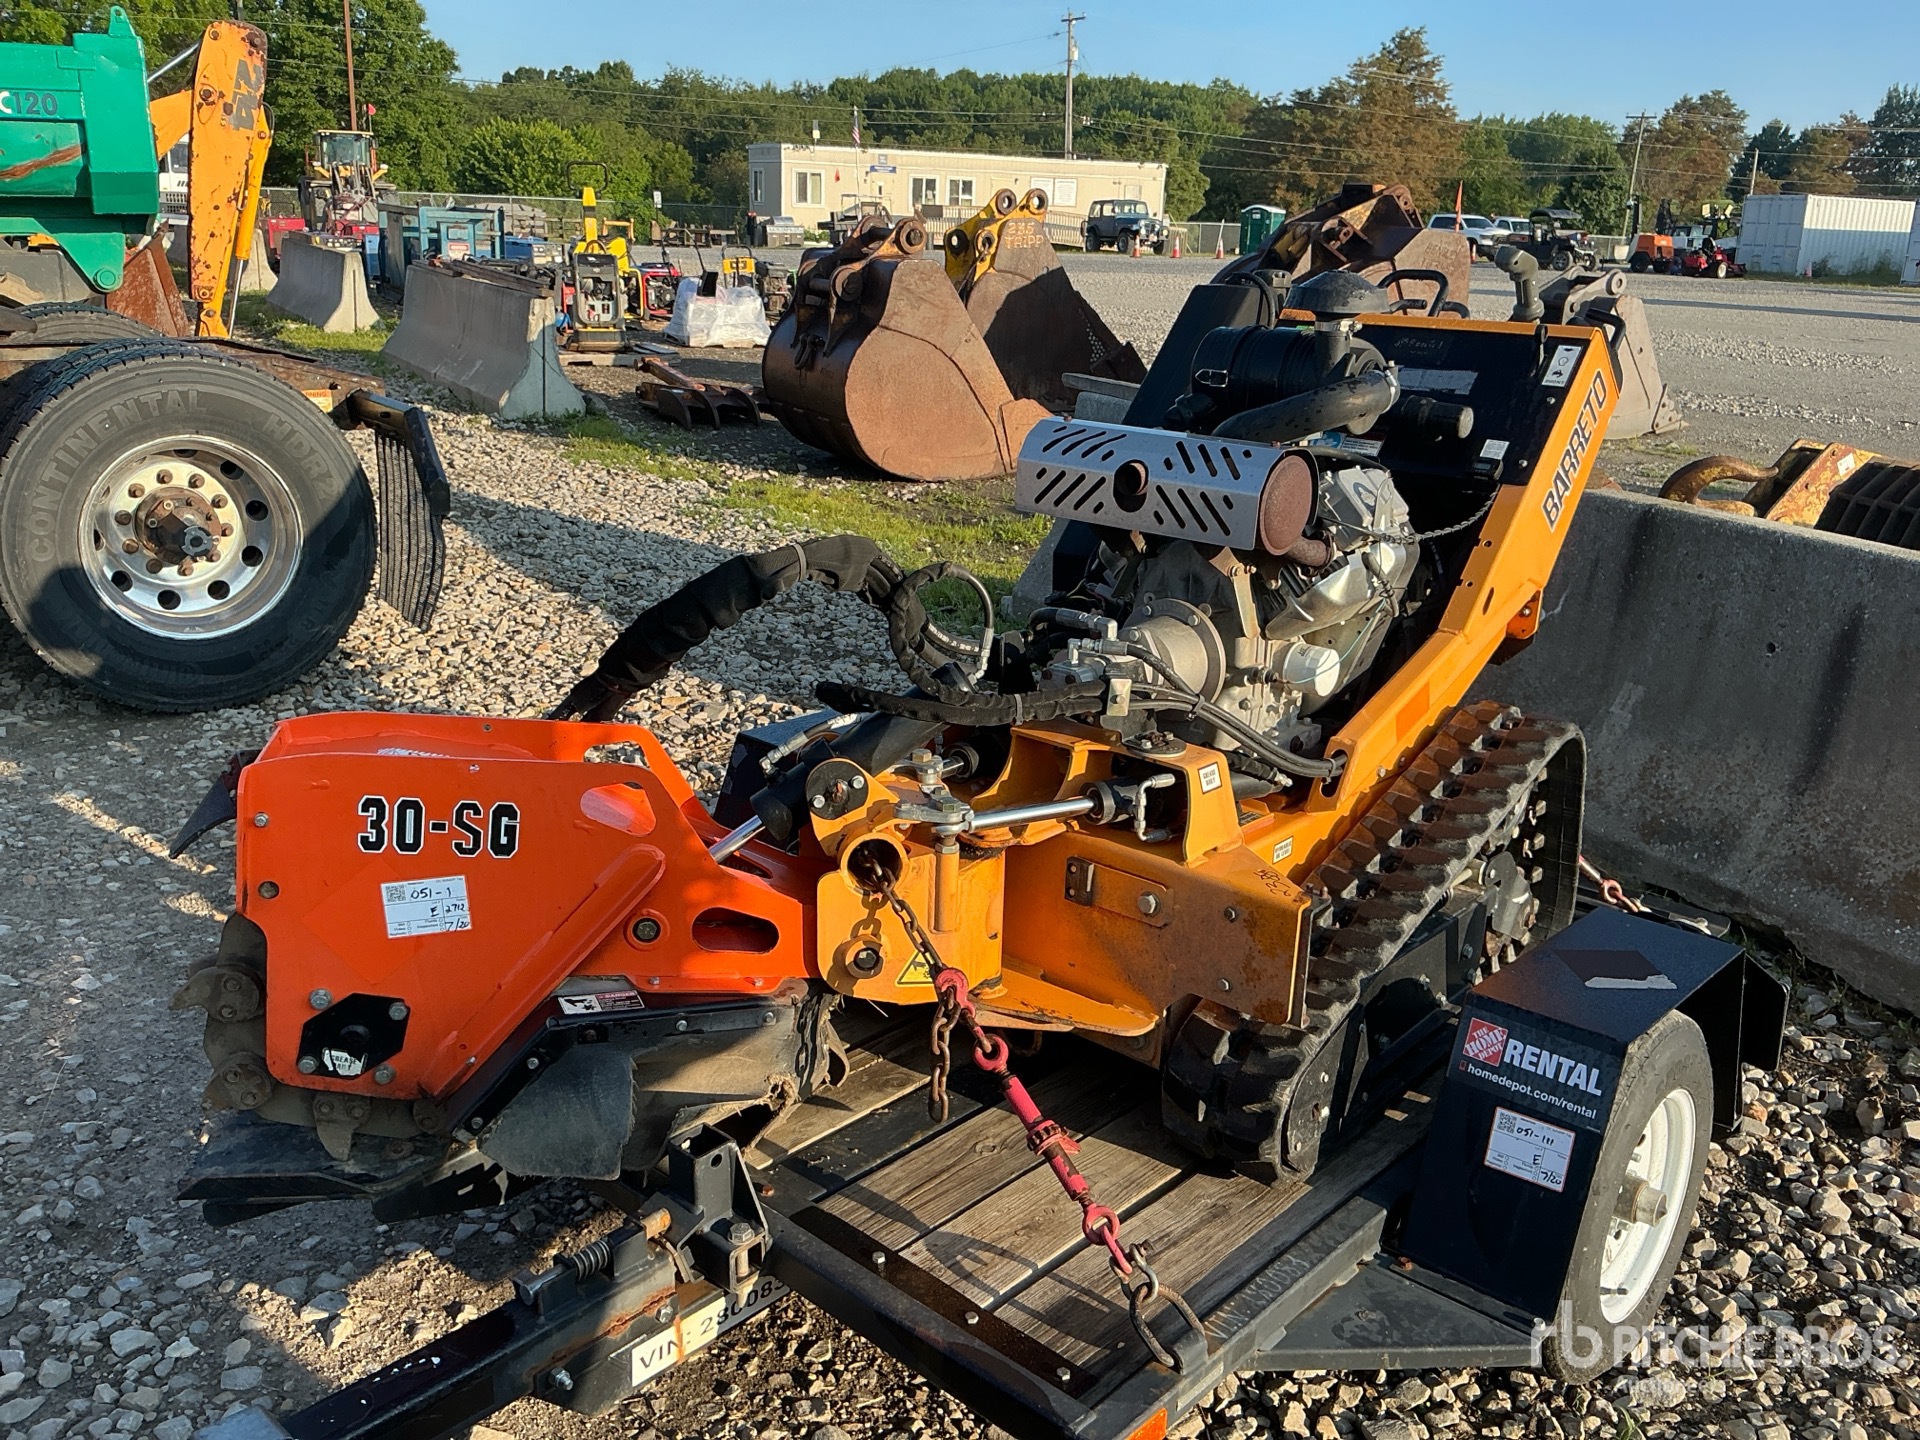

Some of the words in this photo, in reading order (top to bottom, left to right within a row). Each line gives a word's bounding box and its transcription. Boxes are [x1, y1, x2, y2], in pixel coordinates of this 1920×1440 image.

[1541, 368, 1608, 533] BARRETO
[27, 388, 207, 563] CONTINENTAL
[357, 795, 521, 859] 30-SG
[445, 903, 465, 914] 2712
[445, 917, 470, 933] 7/20
[1464, 1026, 1507, 1056] HOME
[1472, 1026, 1489, 1039] THE
[1478, 1042, 1504, 1060] DEPOT
[1503, 1038, 1602, 1097] RENTAL
[1467, 1063, 1597, 1119] homedepot.com/rental
[1541, 1170, 1562, 1185] 7/20
